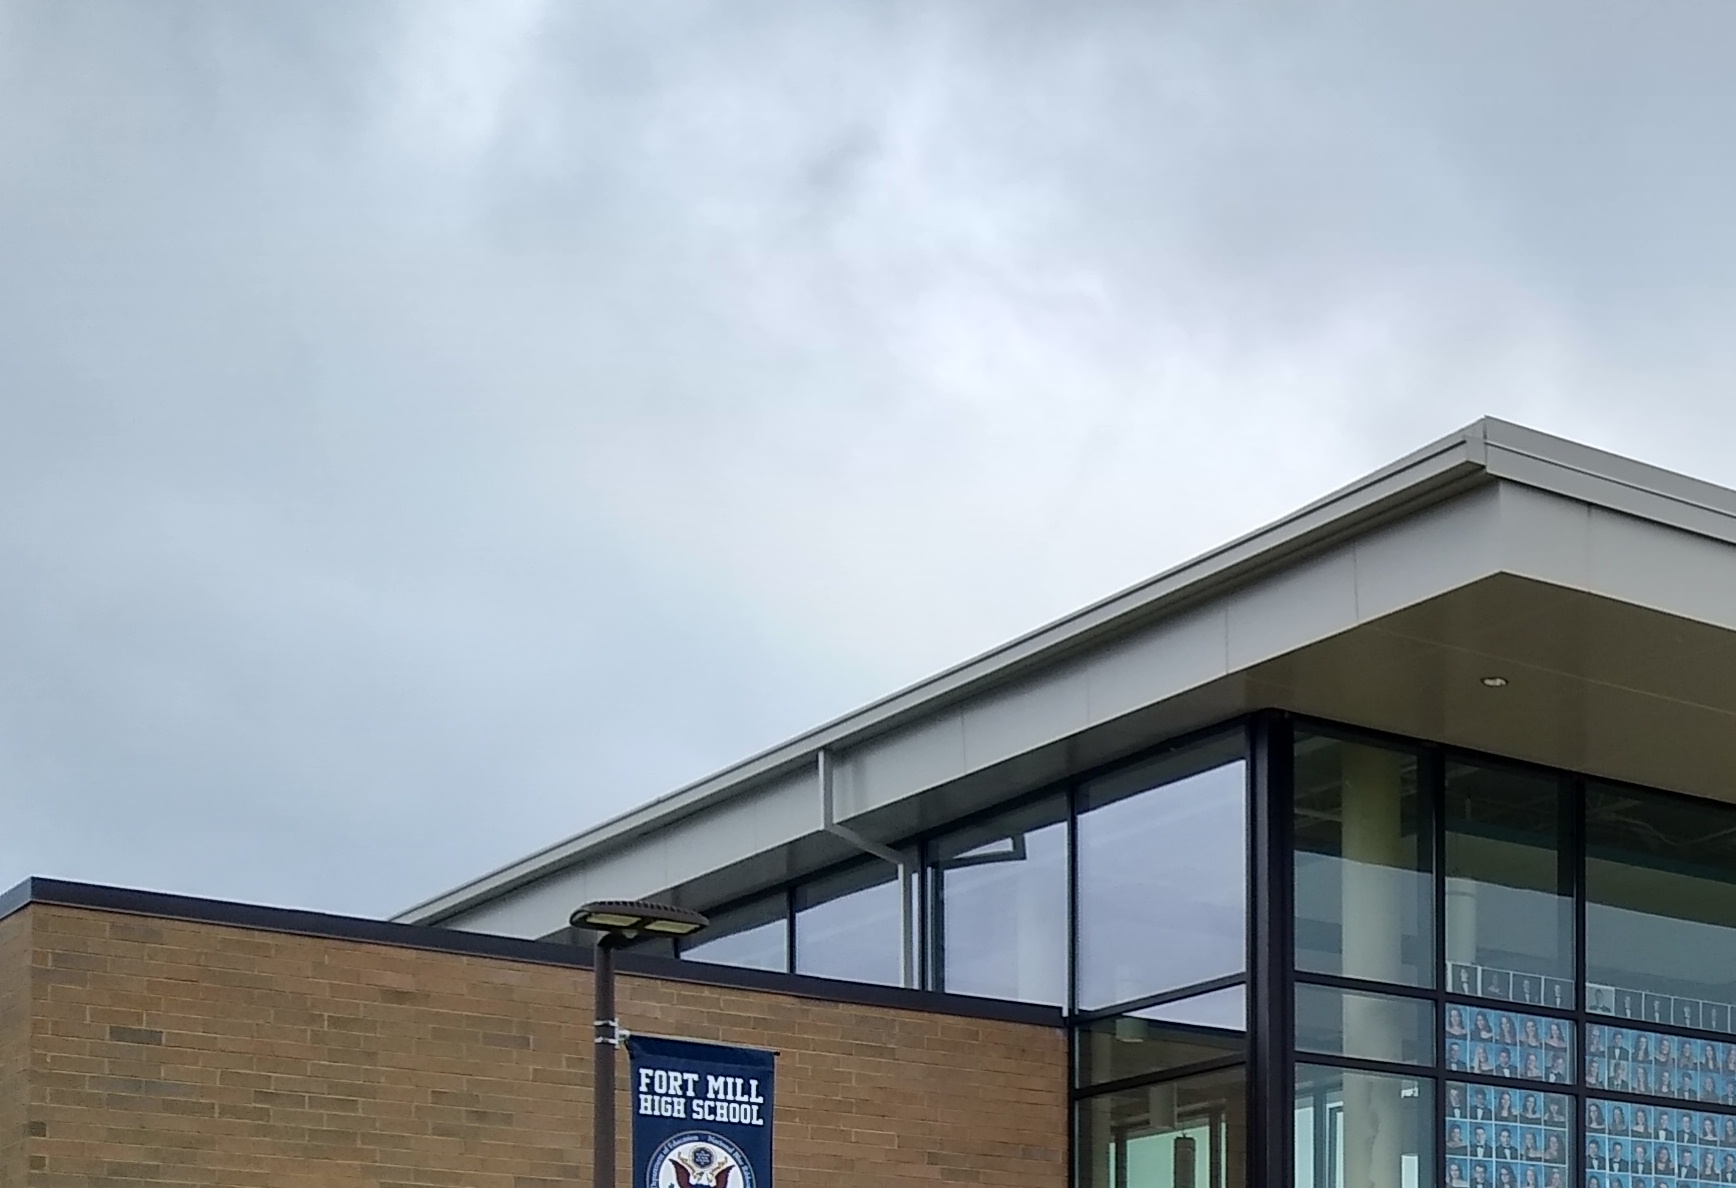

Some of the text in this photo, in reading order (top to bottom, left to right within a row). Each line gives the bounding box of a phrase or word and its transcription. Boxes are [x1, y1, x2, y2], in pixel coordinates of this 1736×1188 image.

[639, 1068, 764, 1103] FORT MILL
[639, 1094, 764, 1125] HIGH SCHOOL
